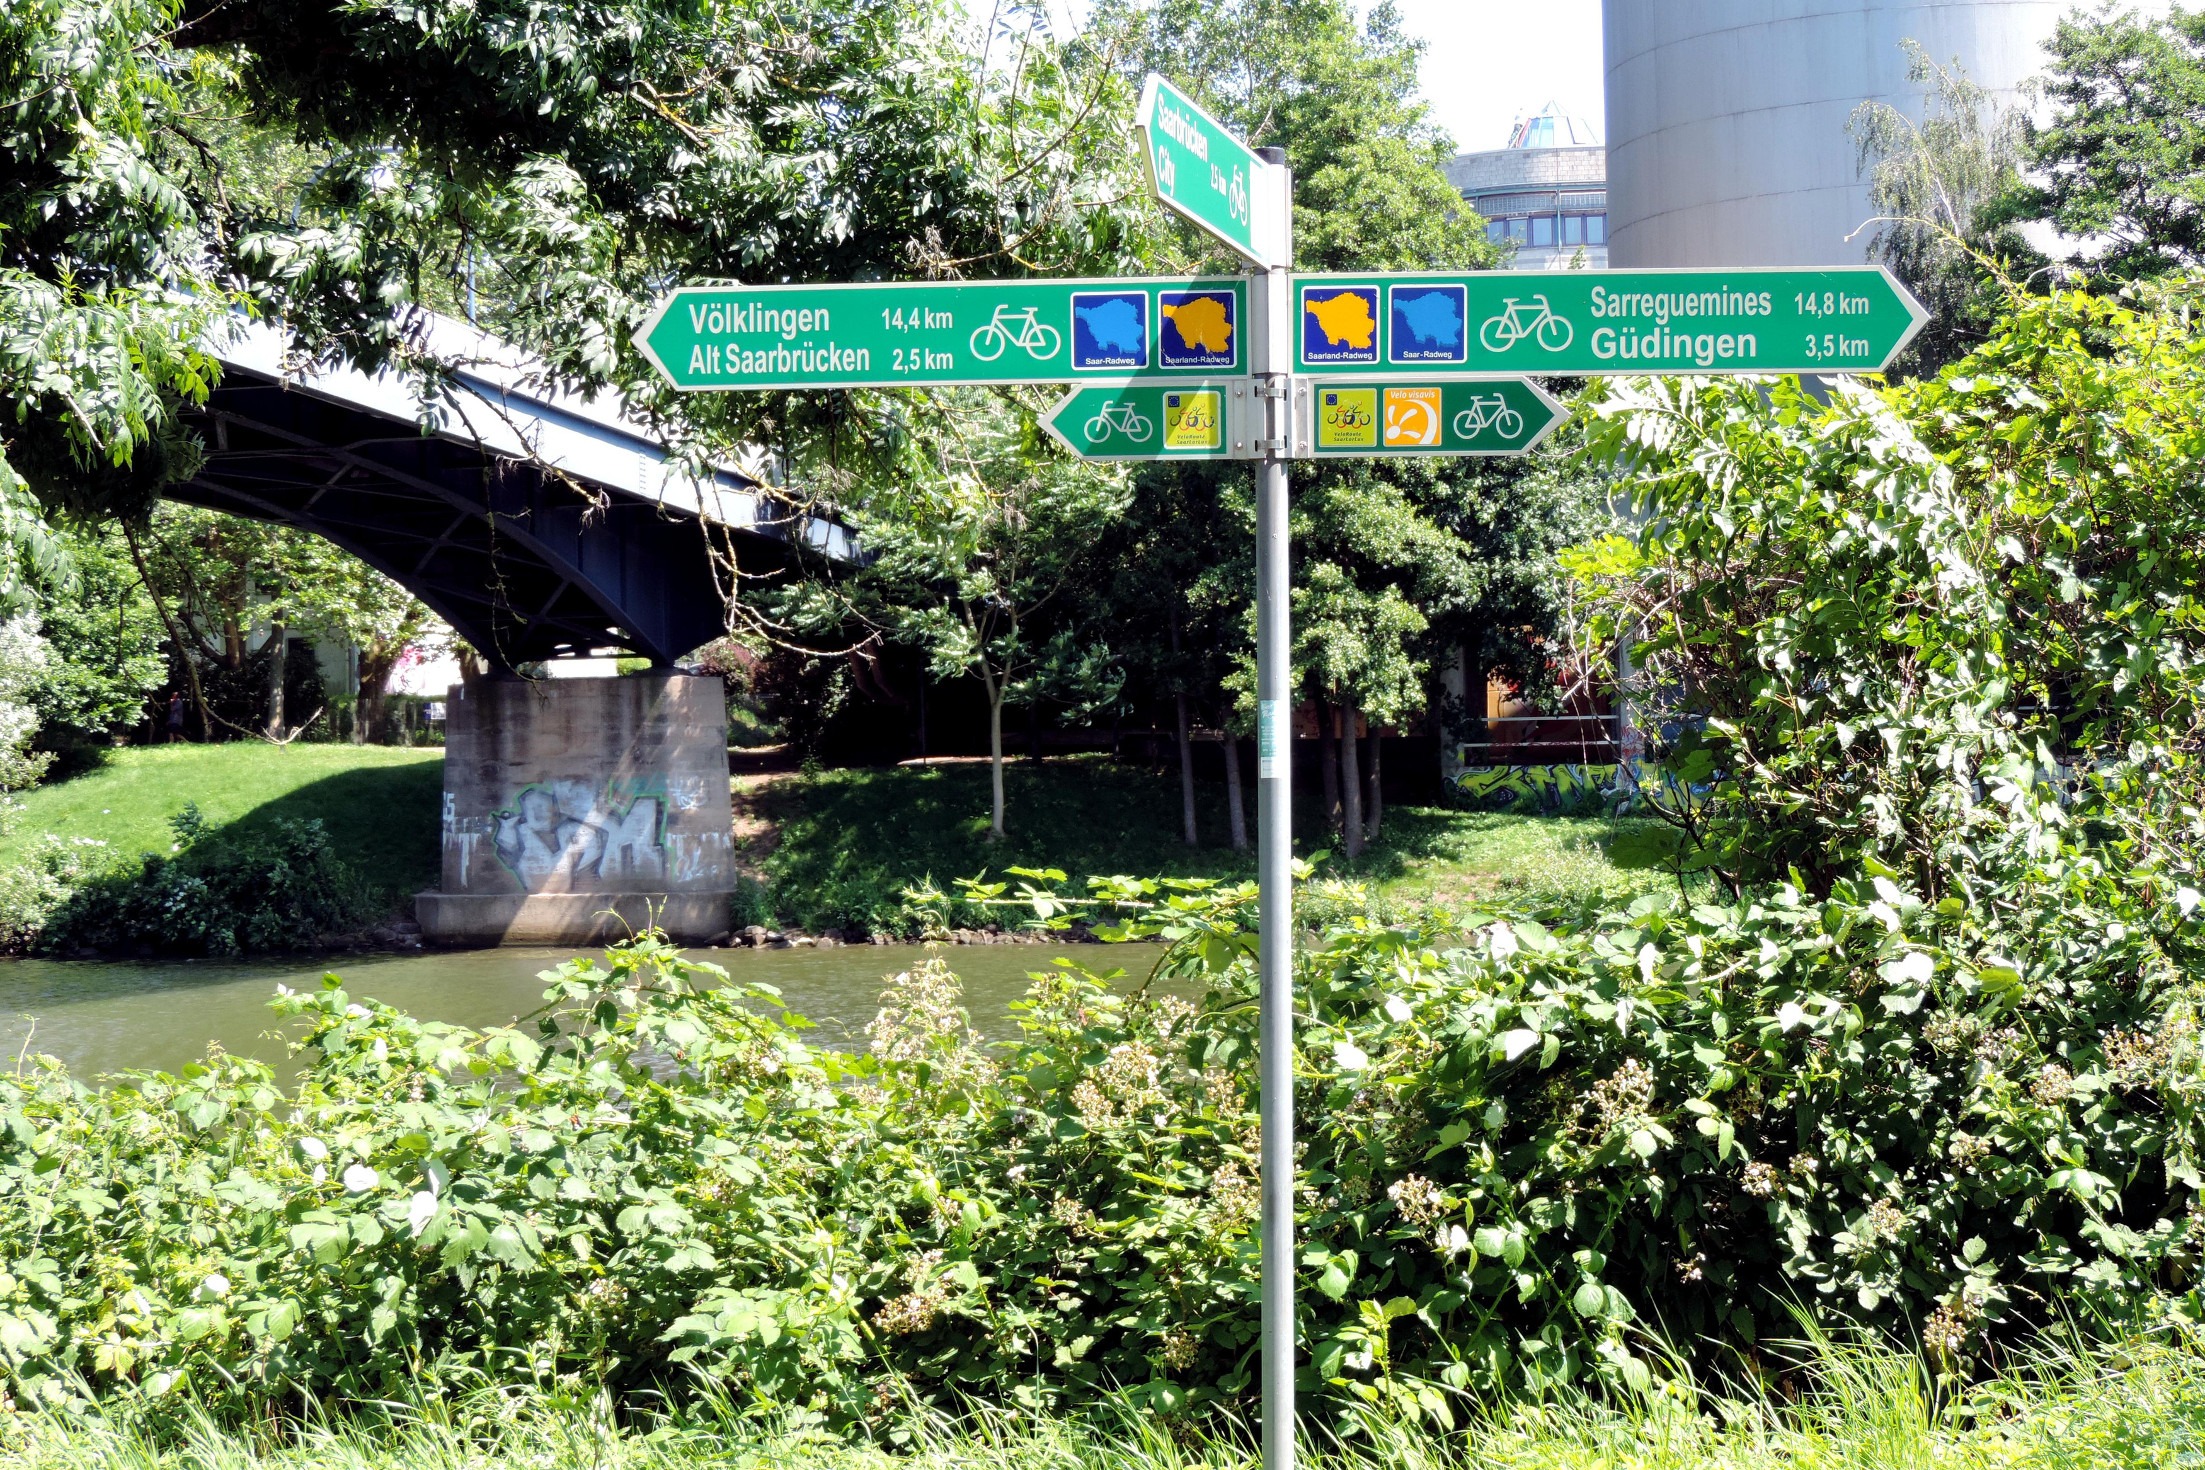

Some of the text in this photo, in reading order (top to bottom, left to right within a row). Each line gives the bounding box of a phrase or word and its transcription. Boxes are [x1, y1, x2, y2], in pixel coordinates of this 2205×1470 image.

[1158, 145, 1175, 198] City
[1590, 285, 1870, 325] Sarreguemines 14,8 km
[688, 302, 953, 341] Völklingen 14,4 km
[1308, 351, 1373, 360] Saarland-Radweg
[1403, 350, 1452, 359] Saar-Radweg
[1591, 327, 1869, 366] Güdingen 3,5 km
[688, 341, 953, 374] Alt Saarbrücken 2,5 km
[1085, 357, 1135, 366] Saar-Radweg
[1165, 355, 1230, 364] Saarland-Radweg
[1390, 389, 1435, 399] Velo visavis
